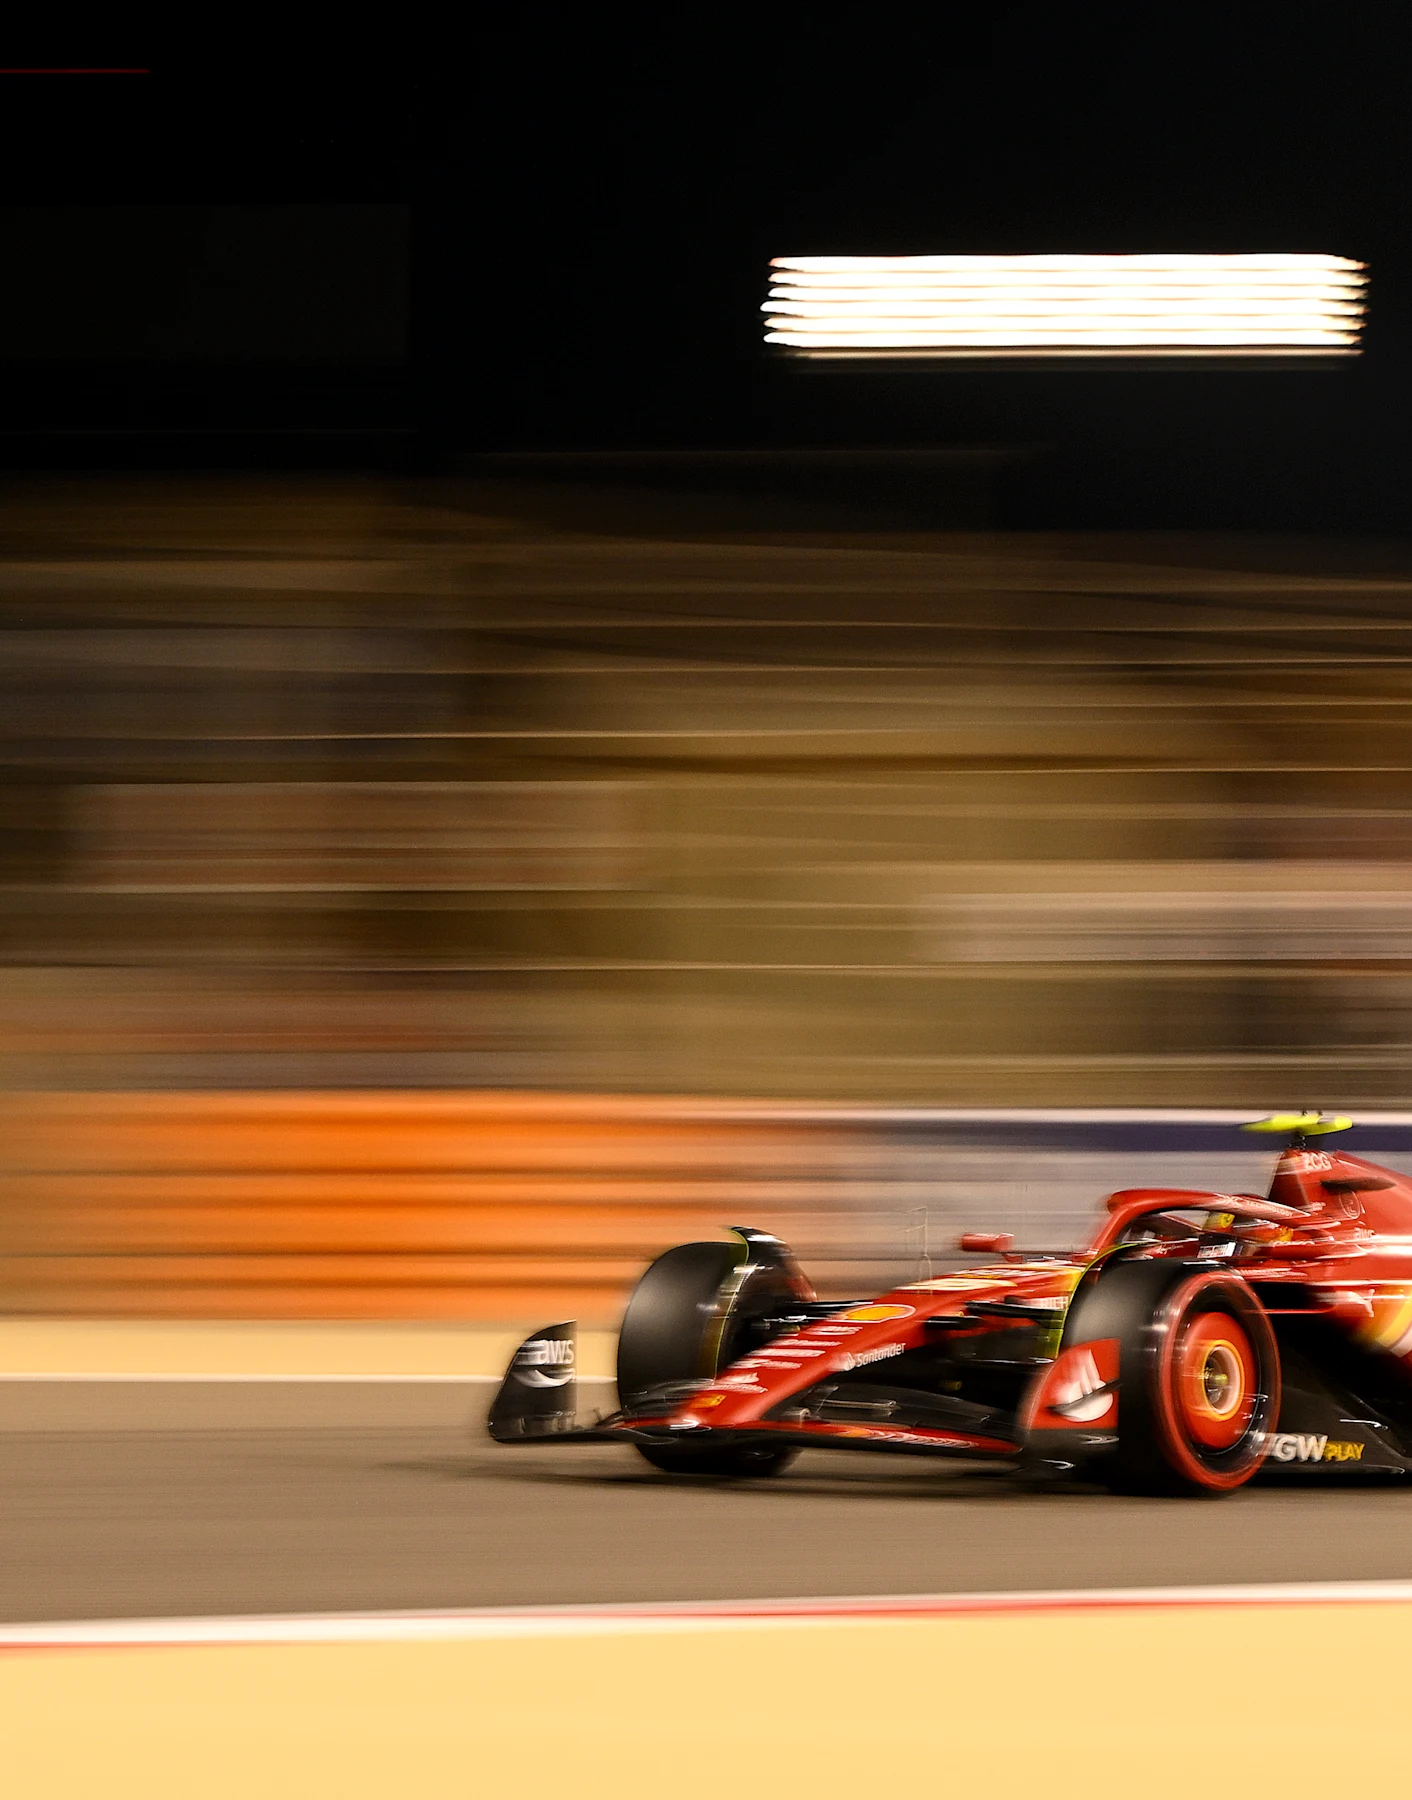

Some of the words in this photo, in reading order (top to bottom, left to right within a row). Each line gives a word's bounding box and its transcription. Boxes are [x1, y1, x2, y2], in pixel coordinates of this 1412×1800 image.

[535, 1339, 575, 1365] aws
[857, 1342, 906, 1368] Santander
[1325, 1441, 1366, 1462] PLAY
